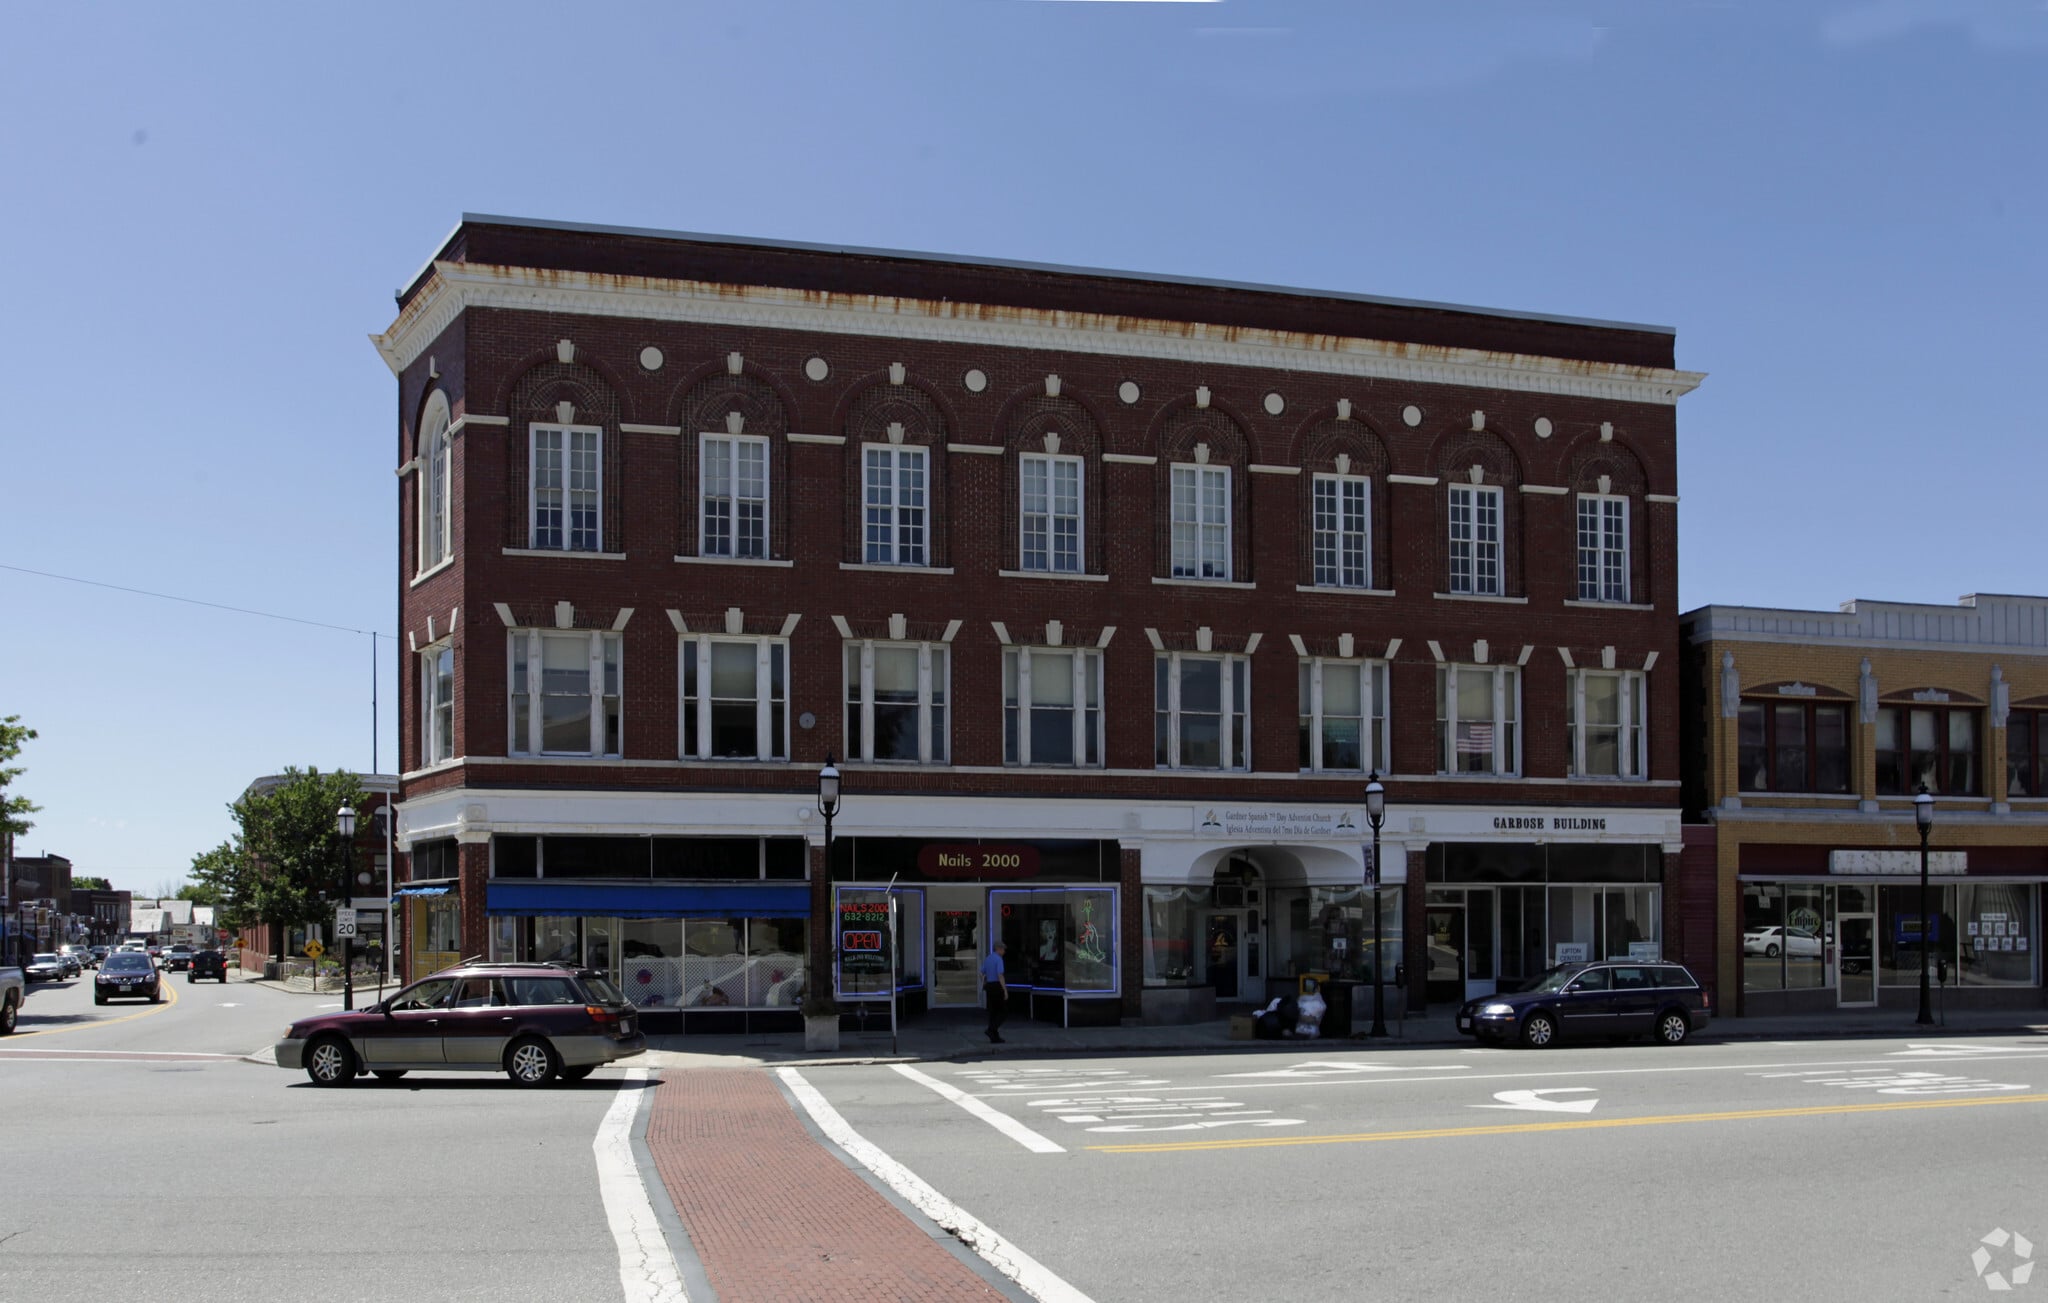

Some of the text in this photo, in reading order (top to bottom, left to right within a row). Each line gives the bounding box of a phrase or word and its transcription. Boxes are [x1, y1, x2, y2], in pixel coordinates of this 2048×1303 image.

[1226, 811, 1247, 820] Gardner
[1248, 812, 1268, 824] Spanish
[1277, 813, 1287, 824] Day
[1312, 813, 1331, 822] Church
[1493, 817, 1606, 830] GARBOSE BUILDING
[1226, 824, 1243, 836] Iglesia
[1273, 826, 1281, 834] del
[1311, 827, 1331, 835] Gardner
[938, 853, 1020, 867] Nails 2000
[840, 904, 868, 913] NAILS
[844, 913, 885, 922] 632-8212
[1787, 914, 1820, 929] Empire
[338, 923, 354, 935] 20
[845, 932, 881, 950] OPEN
